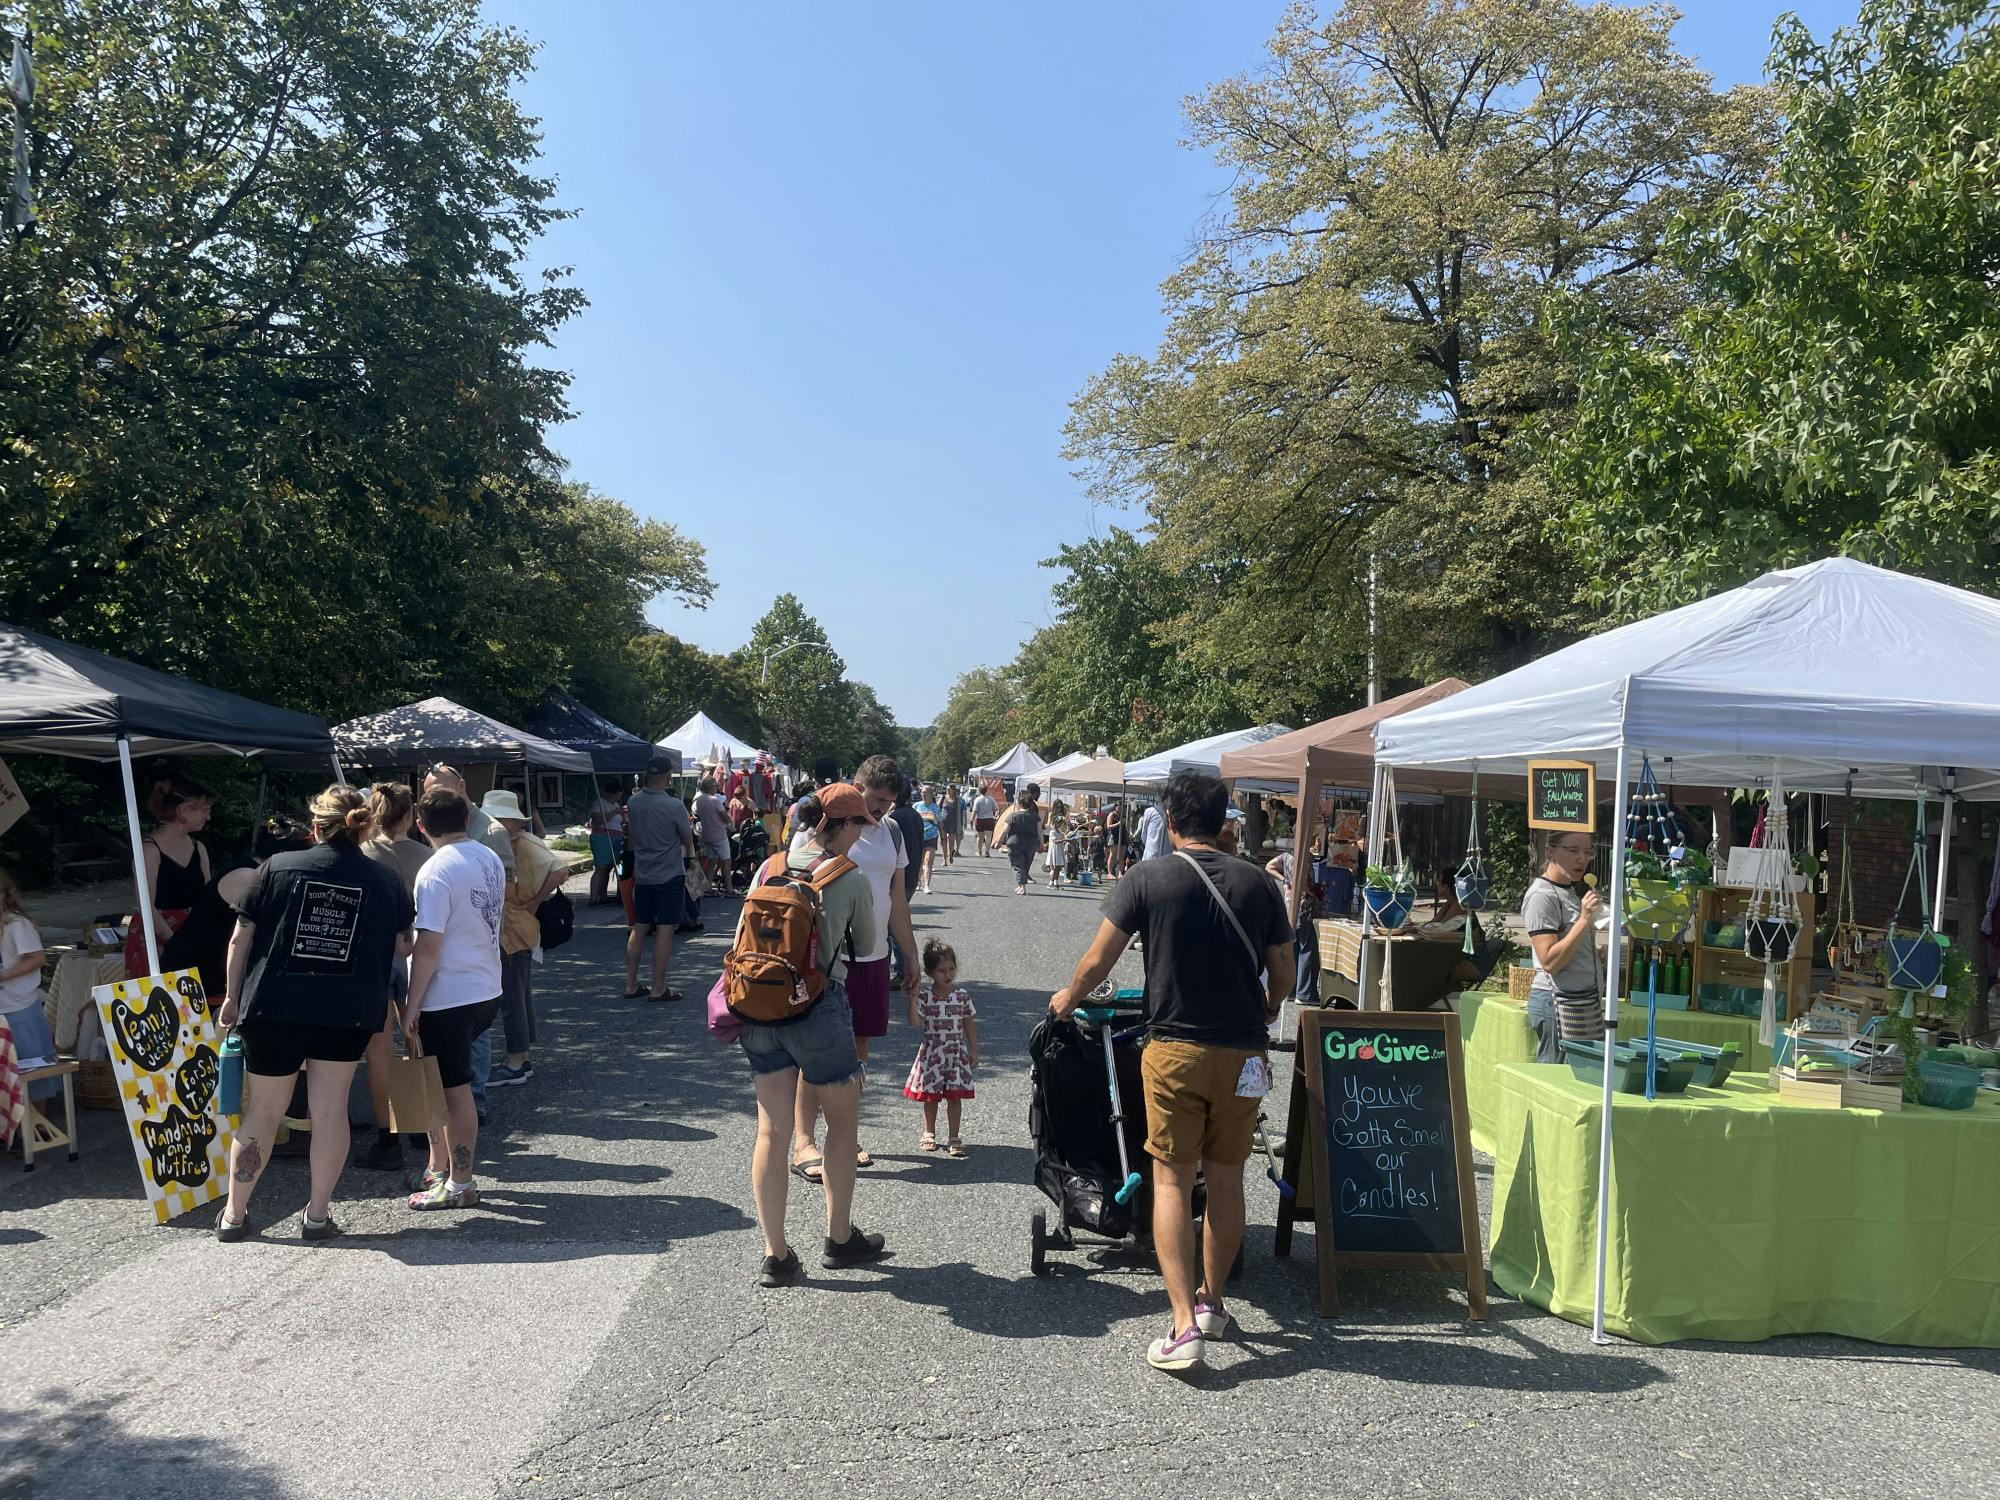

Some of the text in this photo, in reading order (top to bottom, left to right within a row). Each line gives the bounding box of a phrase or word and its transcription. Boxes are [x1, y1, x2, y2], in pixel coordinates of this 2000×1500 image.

[1542, 770, 1581, 789] Get YOUR
[1542, 804, 1560, 818] Seeds
[336, 894, 358, 905] HEART
[312, 907, 347, 918] MUSCLE
[299, 923, 350, 936] YOUR FIST
[181, 979, 199, 994] Art
[193, 997, 205, 1012] By
[116, 1000, 171, 1050] Peanut
[144, 1110, 213, 1149] Handmade
[1332, 1117, 1446, 1147] Gotta Smell
[167, 1138, 191, 1157] and
[1376, 1151, 1411, 1169] our
[1340, 1170, 1439, 1214] Candles!
